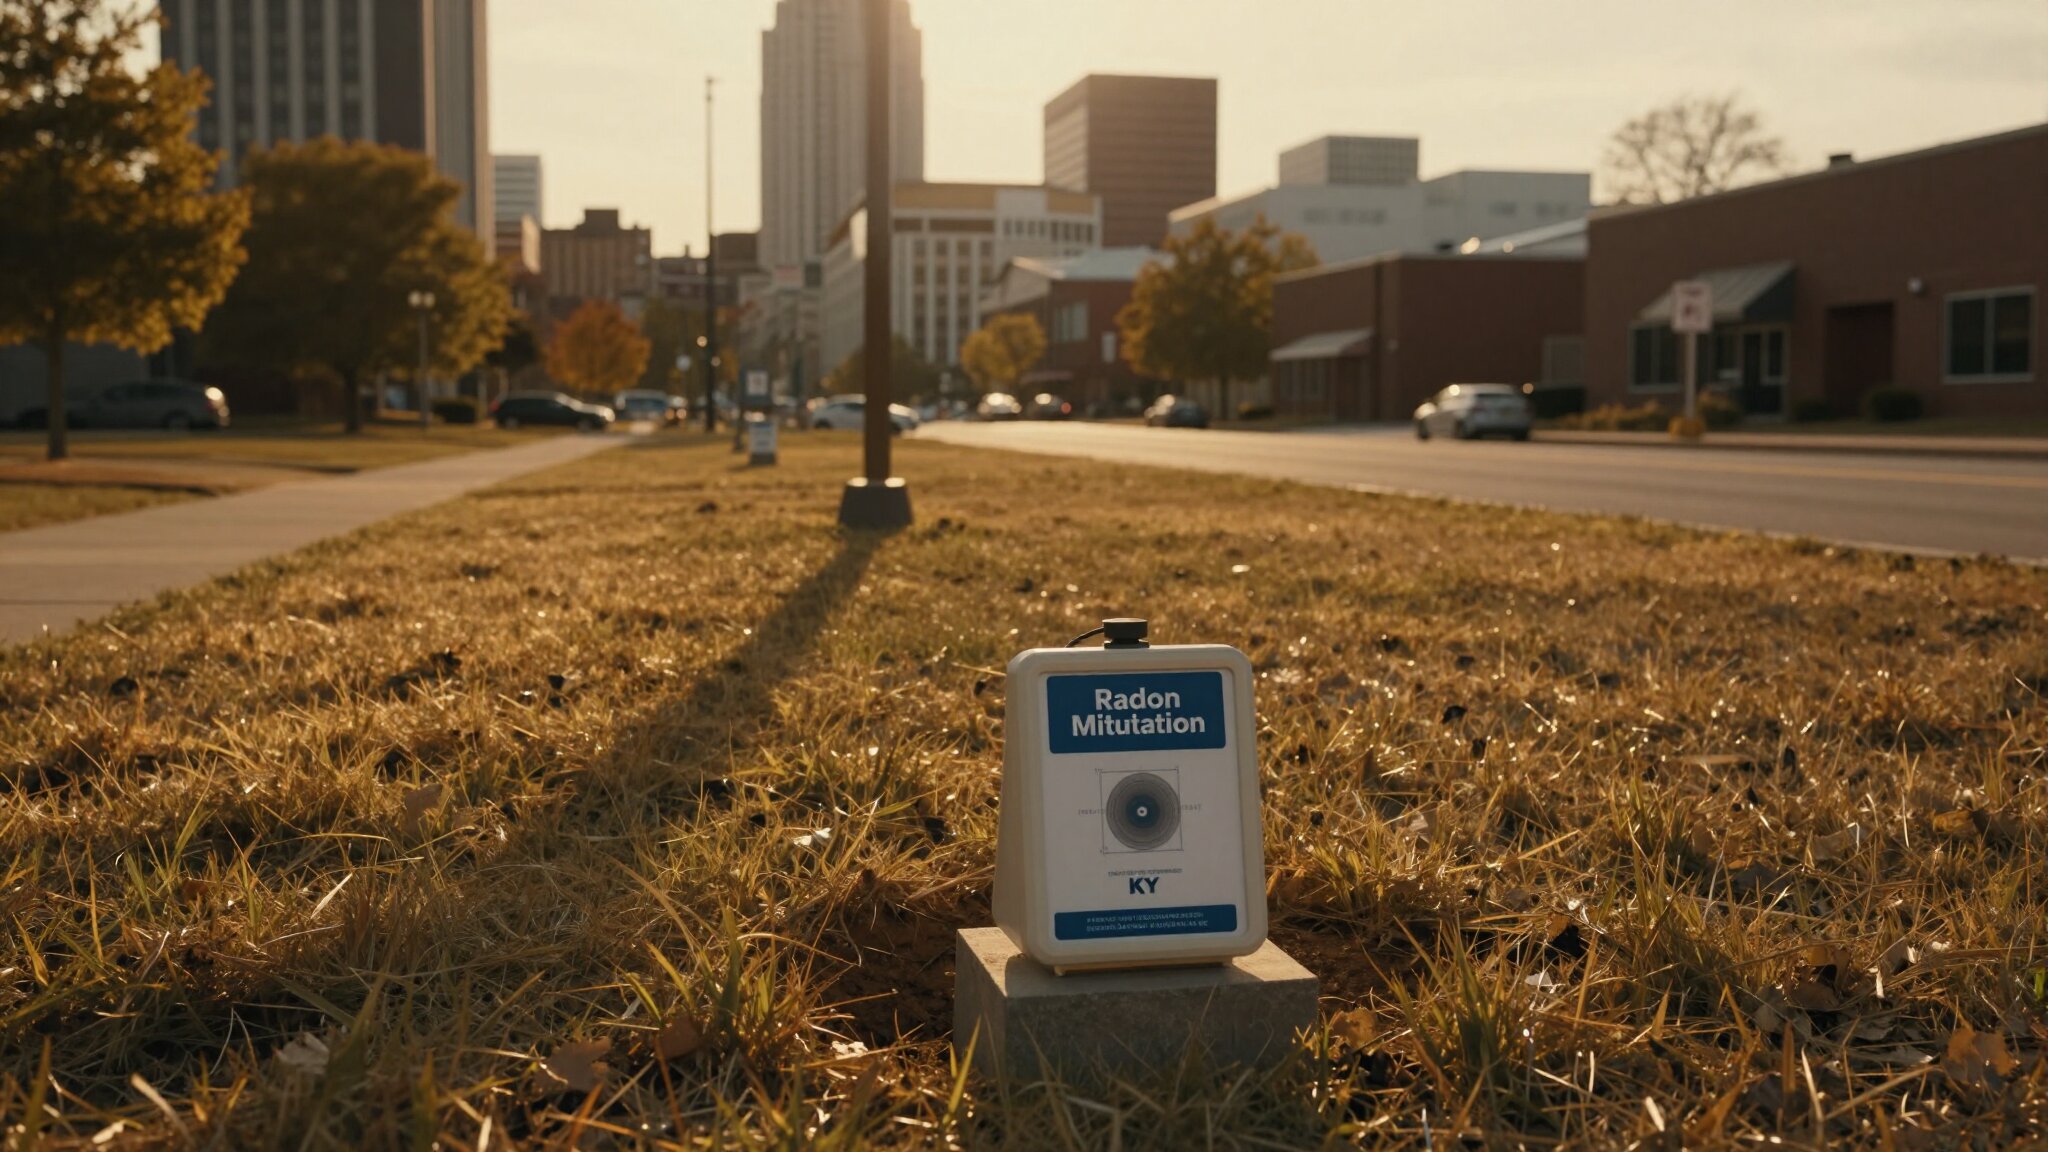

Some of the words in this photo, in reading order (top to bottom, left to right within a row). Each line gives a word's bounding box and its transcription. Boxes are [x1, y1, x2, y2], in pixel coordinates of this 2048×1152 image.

[1095, 688, 1181, 711] Radon
[1072, 712, 1205, 737] Mitutation
[1129, 877, 1160, 895] KY
